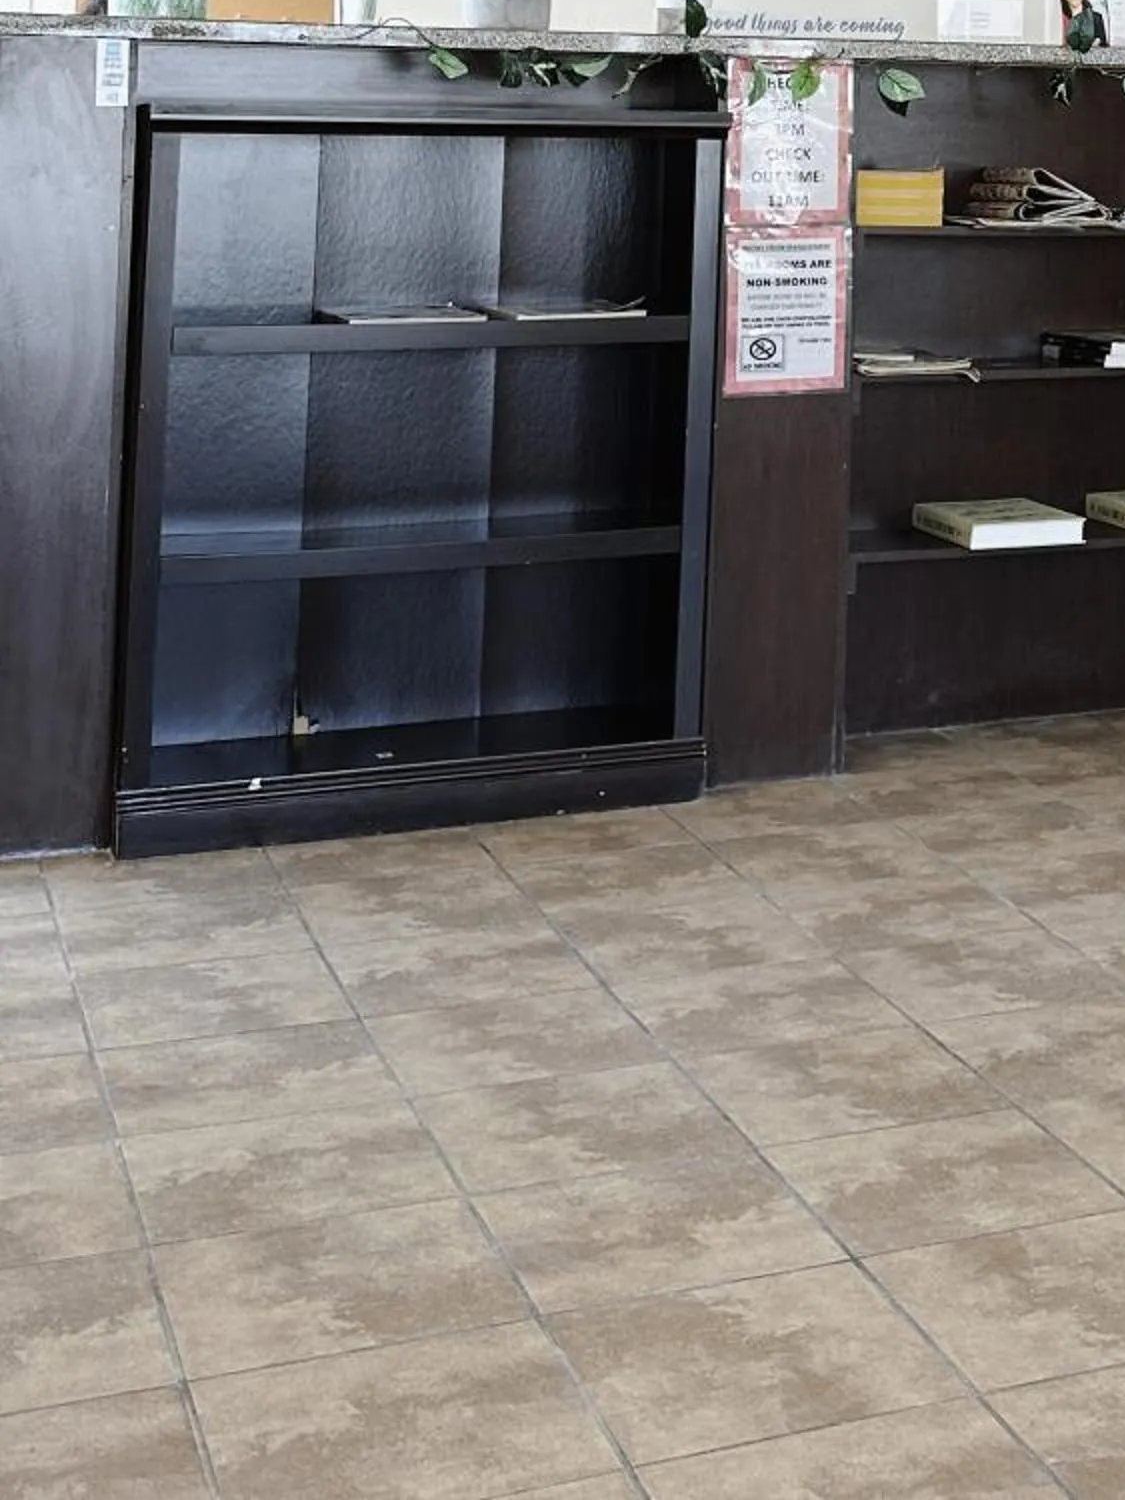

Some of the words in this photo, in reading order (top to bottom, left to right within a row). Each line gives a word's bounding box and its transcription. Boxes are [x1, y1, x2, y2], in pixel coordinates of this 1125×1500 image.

[703, 13, 748, 36] good
[751, 11, 799, 37] things
[803, 16, 835, 34] are
[839, 17, 905, 43] coming
[810, 259, 832, 268] ARE
[746, 277, 828, 288] NON-SMOKING
